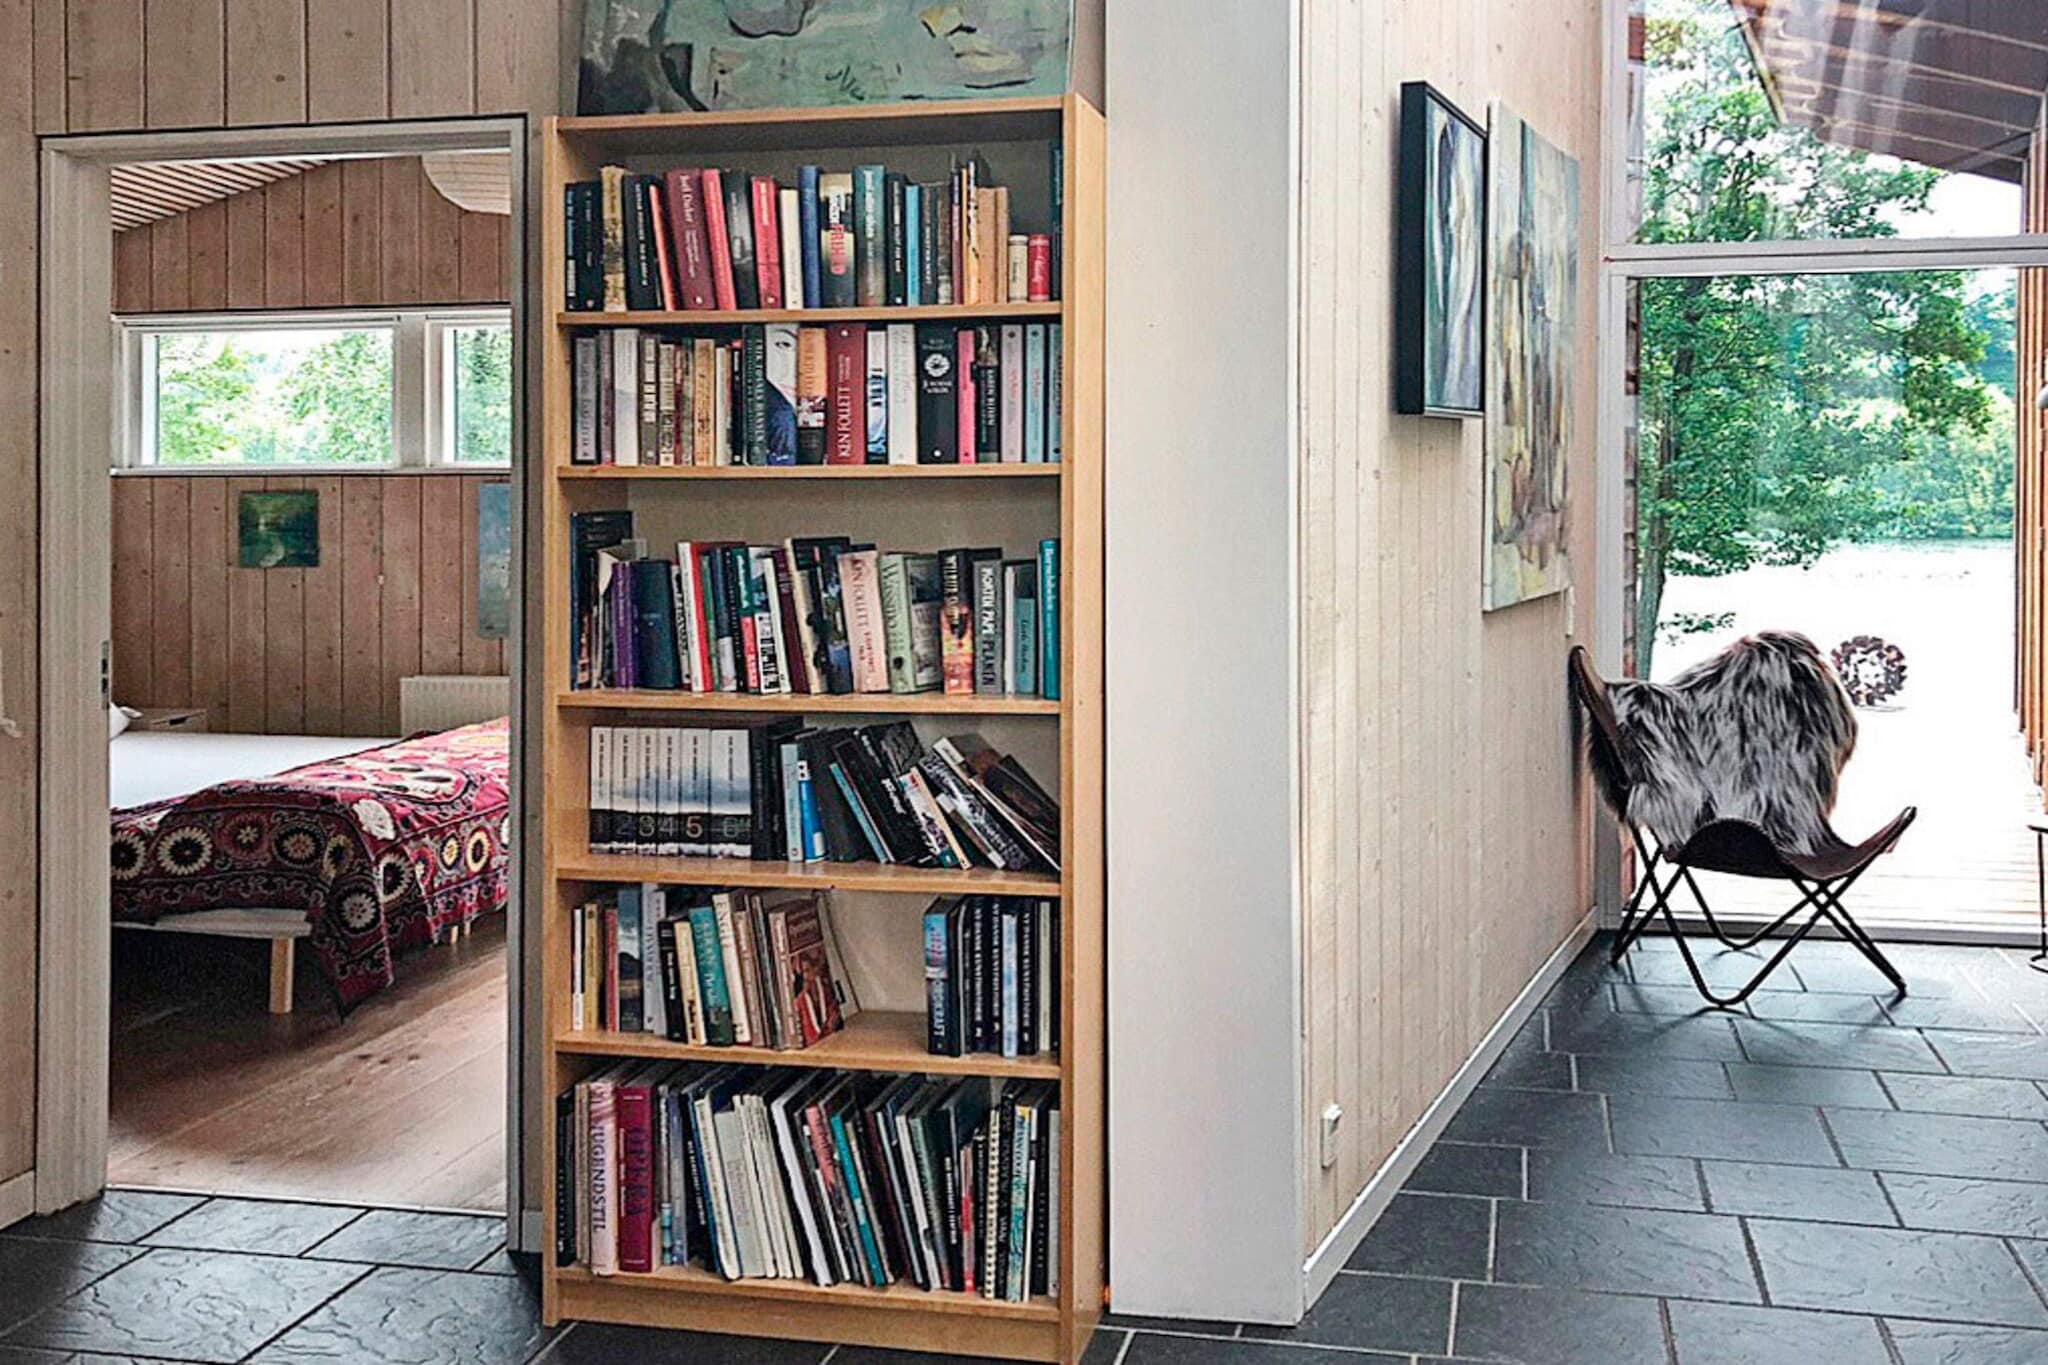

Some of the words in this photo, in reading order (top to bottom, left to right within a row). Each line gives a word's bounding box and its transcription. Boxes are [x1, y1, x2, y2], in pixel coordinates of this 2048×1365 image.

[837, 386, 851, 431] FOLLETT
[838, 432, 851, 457] KEN
[851, 558, 865, 583] KEN
[943, 555, 959, 594] WILBUR
[981, 567, 994, 607] MORTEN
[982, 609, 995, 634] PAPE
[982, 639, 997, 686] PLANEN
[639, 815, 656, 837] 3
[686, 815, 703, 838] 5
[590, 1123, 606, 1233] JUGENDSTIL
[626, 1126, 648, 1217] OPERA
